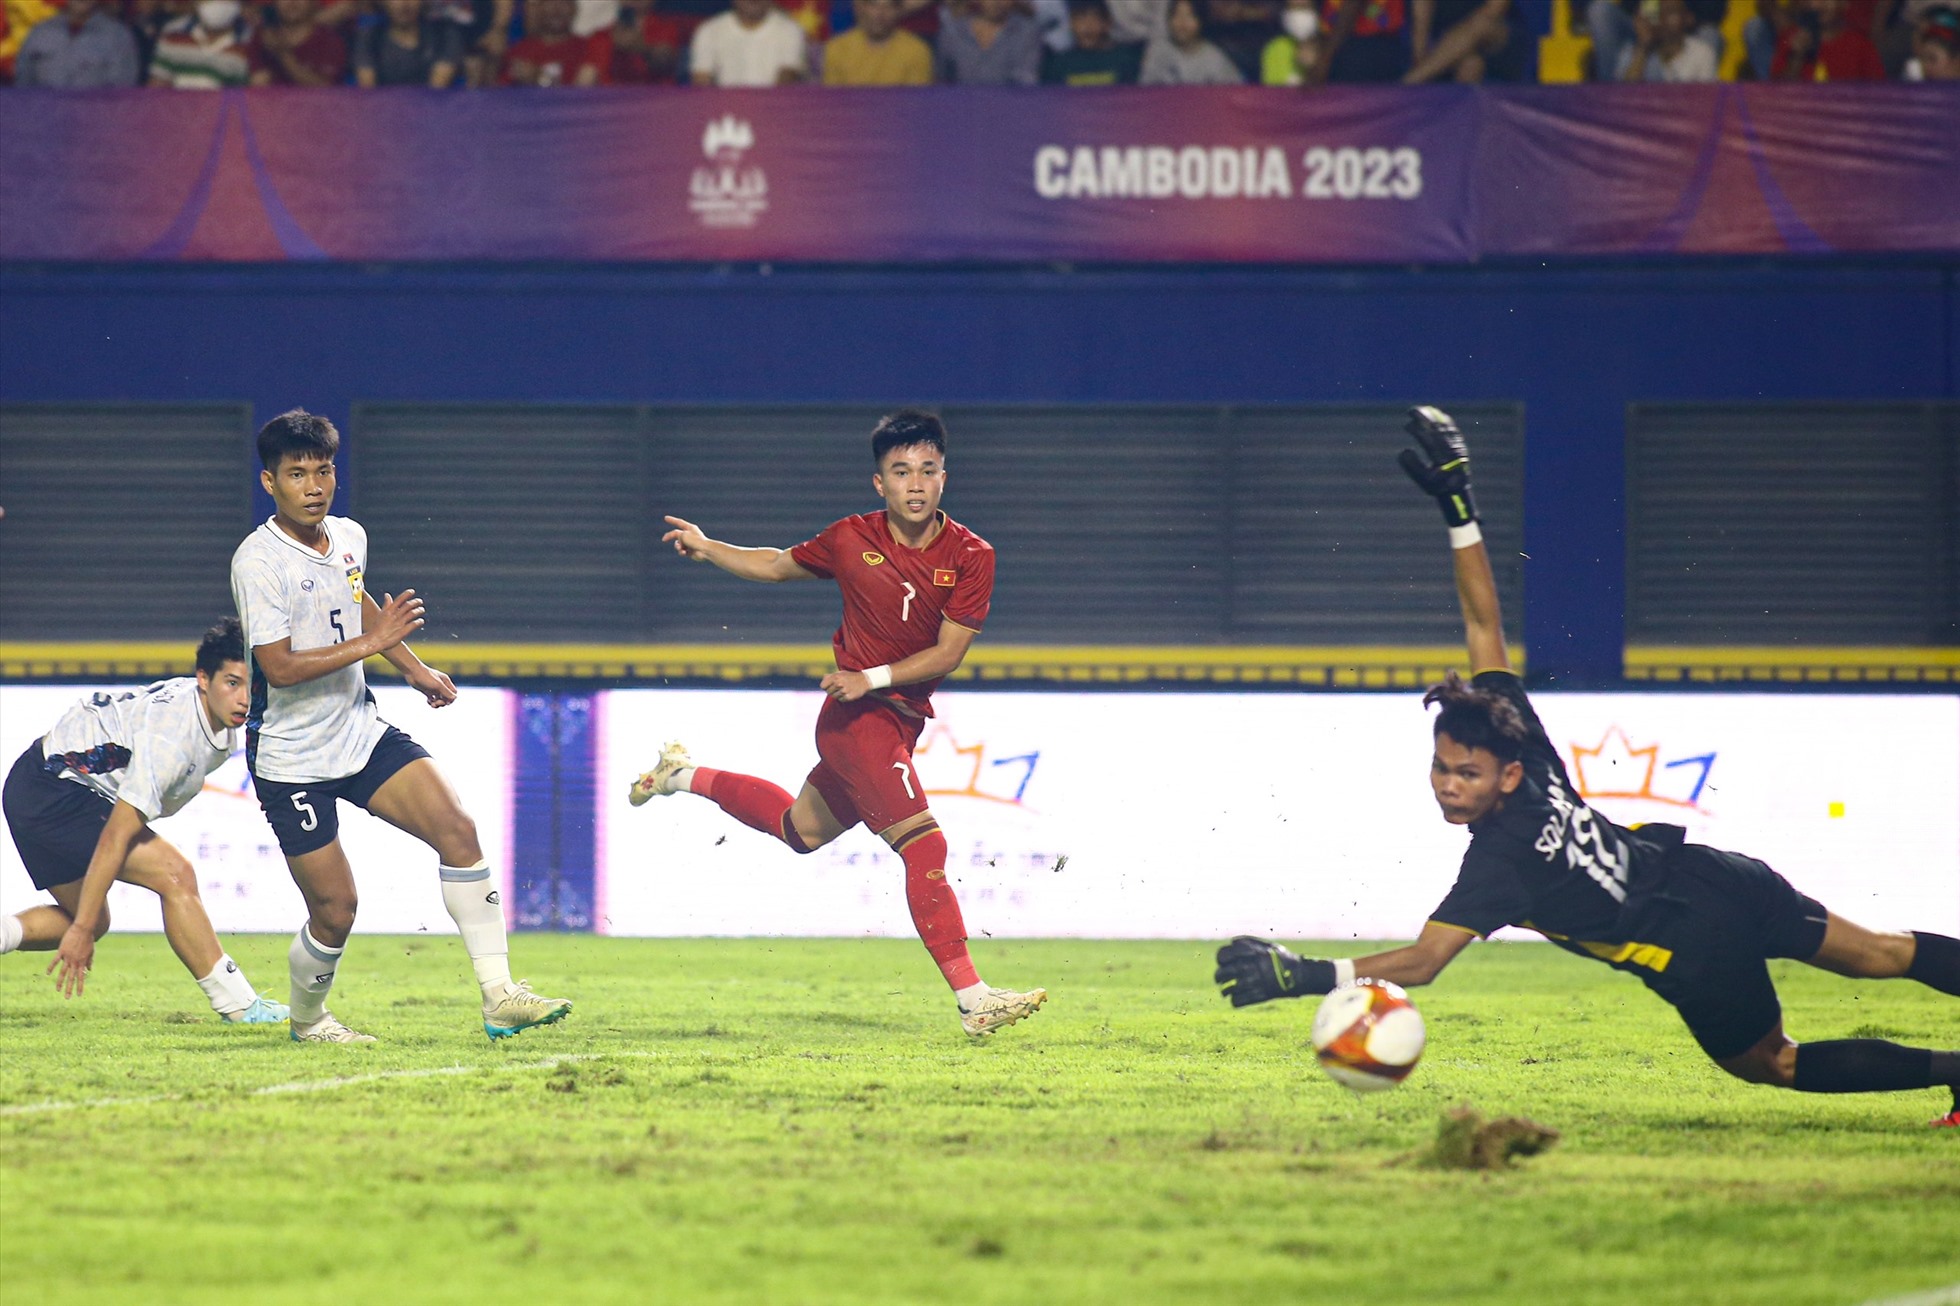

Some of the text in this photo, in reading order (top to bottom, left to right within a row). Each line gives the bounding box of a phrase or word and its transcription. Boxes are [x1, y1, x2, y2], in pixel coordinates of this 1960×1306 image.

[1034, 146, 1422, 199] CAMBODIA 2023
[900, 581, 916, 621] 7
[330, 608, 345, 645] 5
[892, 761, 915, 800] 7
[290, 791, 318, 831] 5
